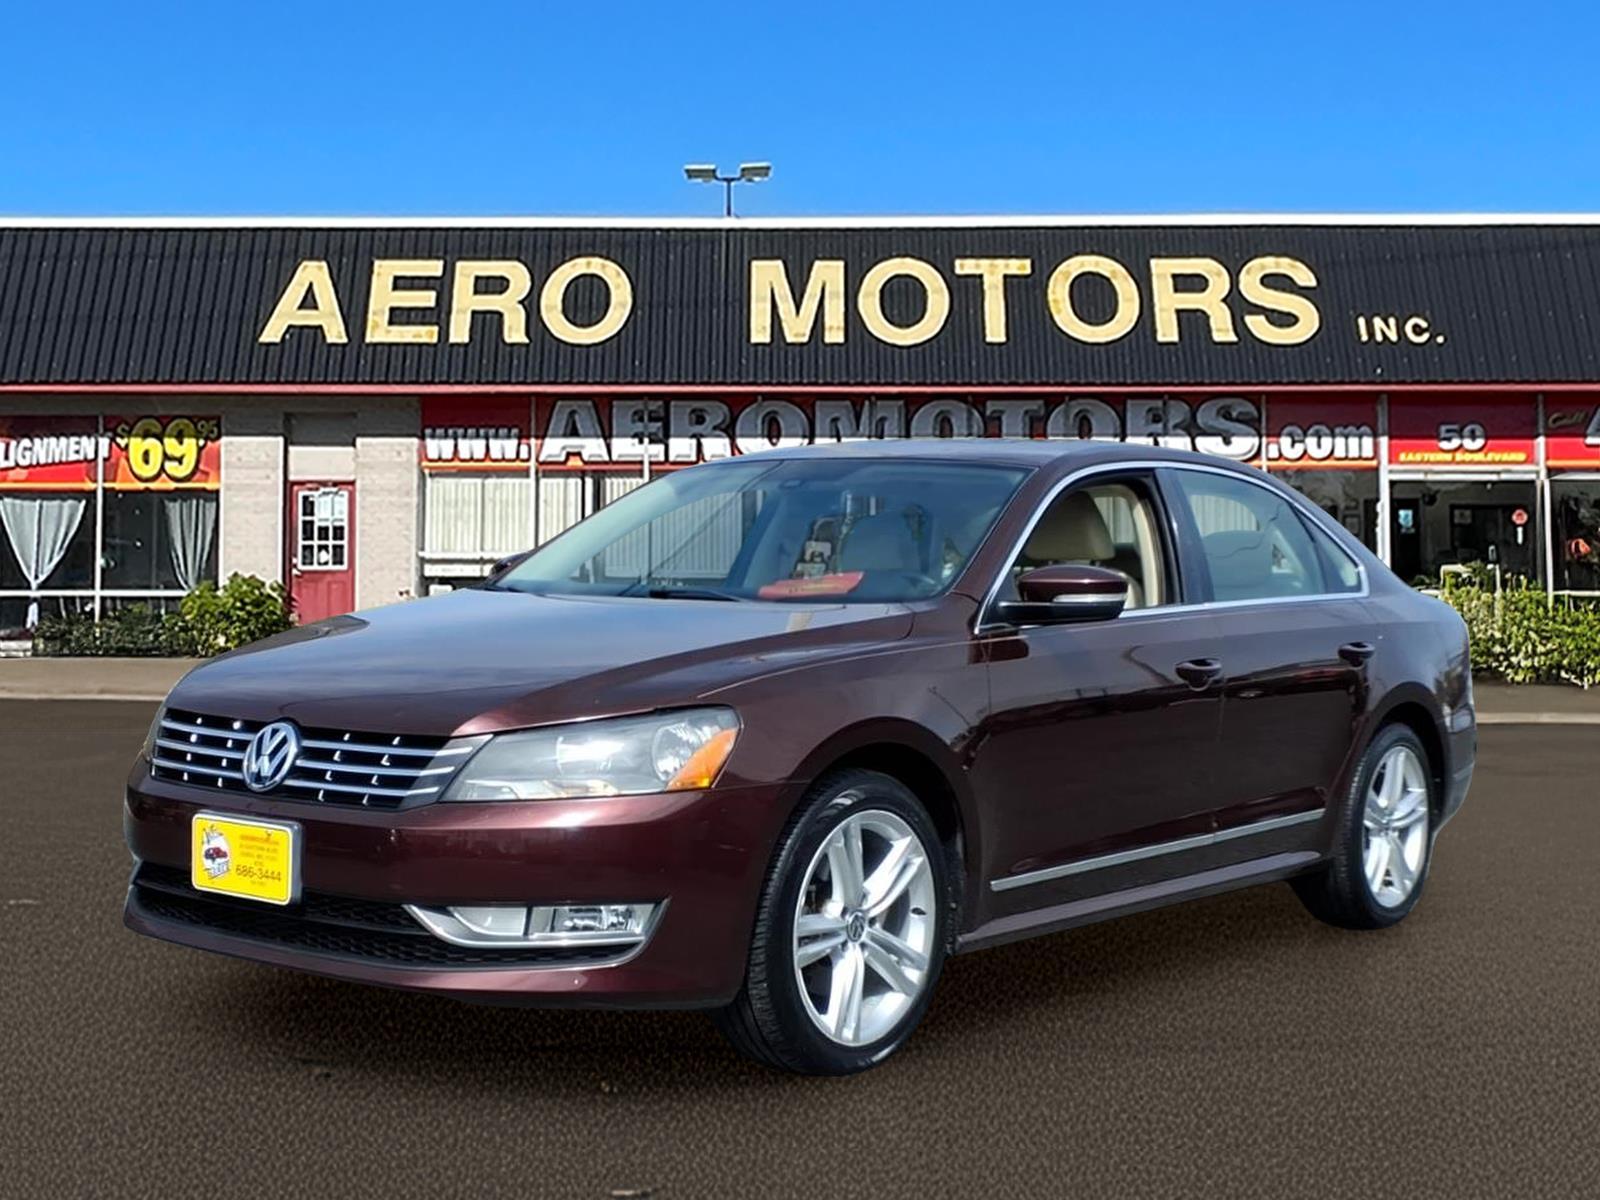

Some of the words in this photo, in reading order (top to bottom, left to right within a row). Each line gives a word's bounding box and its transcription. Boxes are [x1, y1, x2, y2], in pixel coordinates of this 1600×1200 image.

[258, 256, 634, 346] AERO
[749, 254, 1320, 347] MOTORS
[1357, 315, 1447, 344] INC.
[1439, 423, 1486, 450] 50
[1399, 451, 1453, 462] EASTERN
[1455, 451, 1527, 462] BOULEVARD
